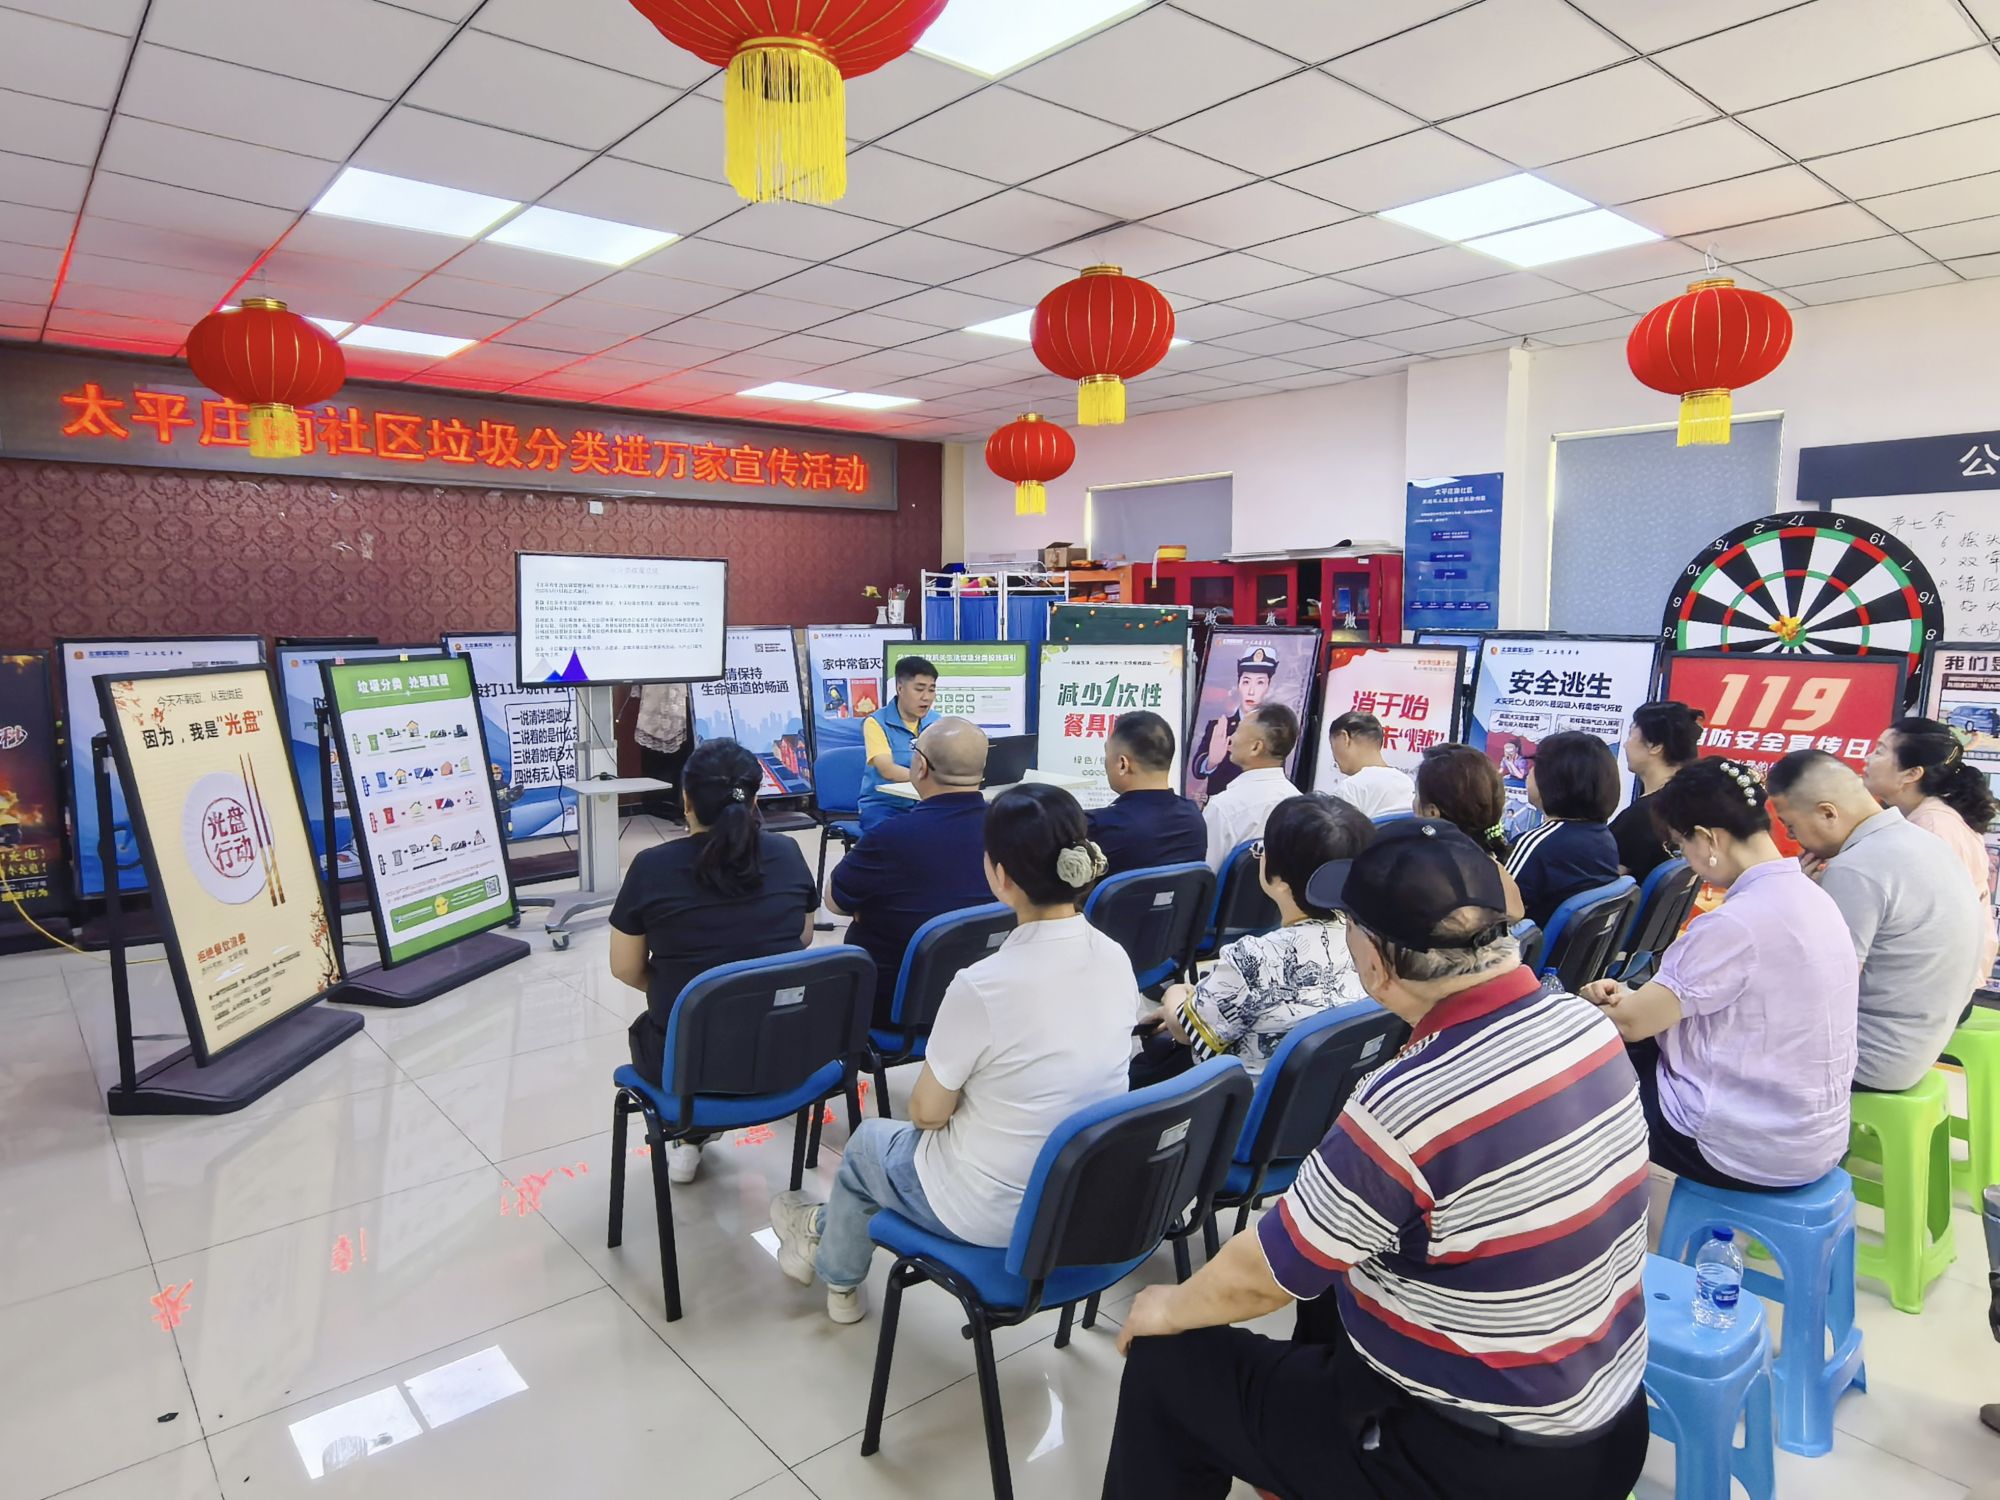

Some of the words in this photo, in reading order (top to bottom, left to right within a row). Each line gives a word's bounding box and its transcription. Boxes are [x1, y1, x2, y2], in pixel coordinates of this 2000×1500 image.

[1959, 444, 2000, 477] 公
[823, 658, 883, 671] 家中常备灭
[701, 680, 789, 696] 生命通道的畅通
[1057, 674, 1162, 708] 减少1次性
[1509, 669, 1613, 699] 安全逃生
[1350, 690, 1429, 721] 消于始
[1710, 674, 1851, 731] 119
[1064, 713, 1116, 738] 餐具
[208, 806, 248, 840] 光盘
[214, 834, 255, 872] 行动
